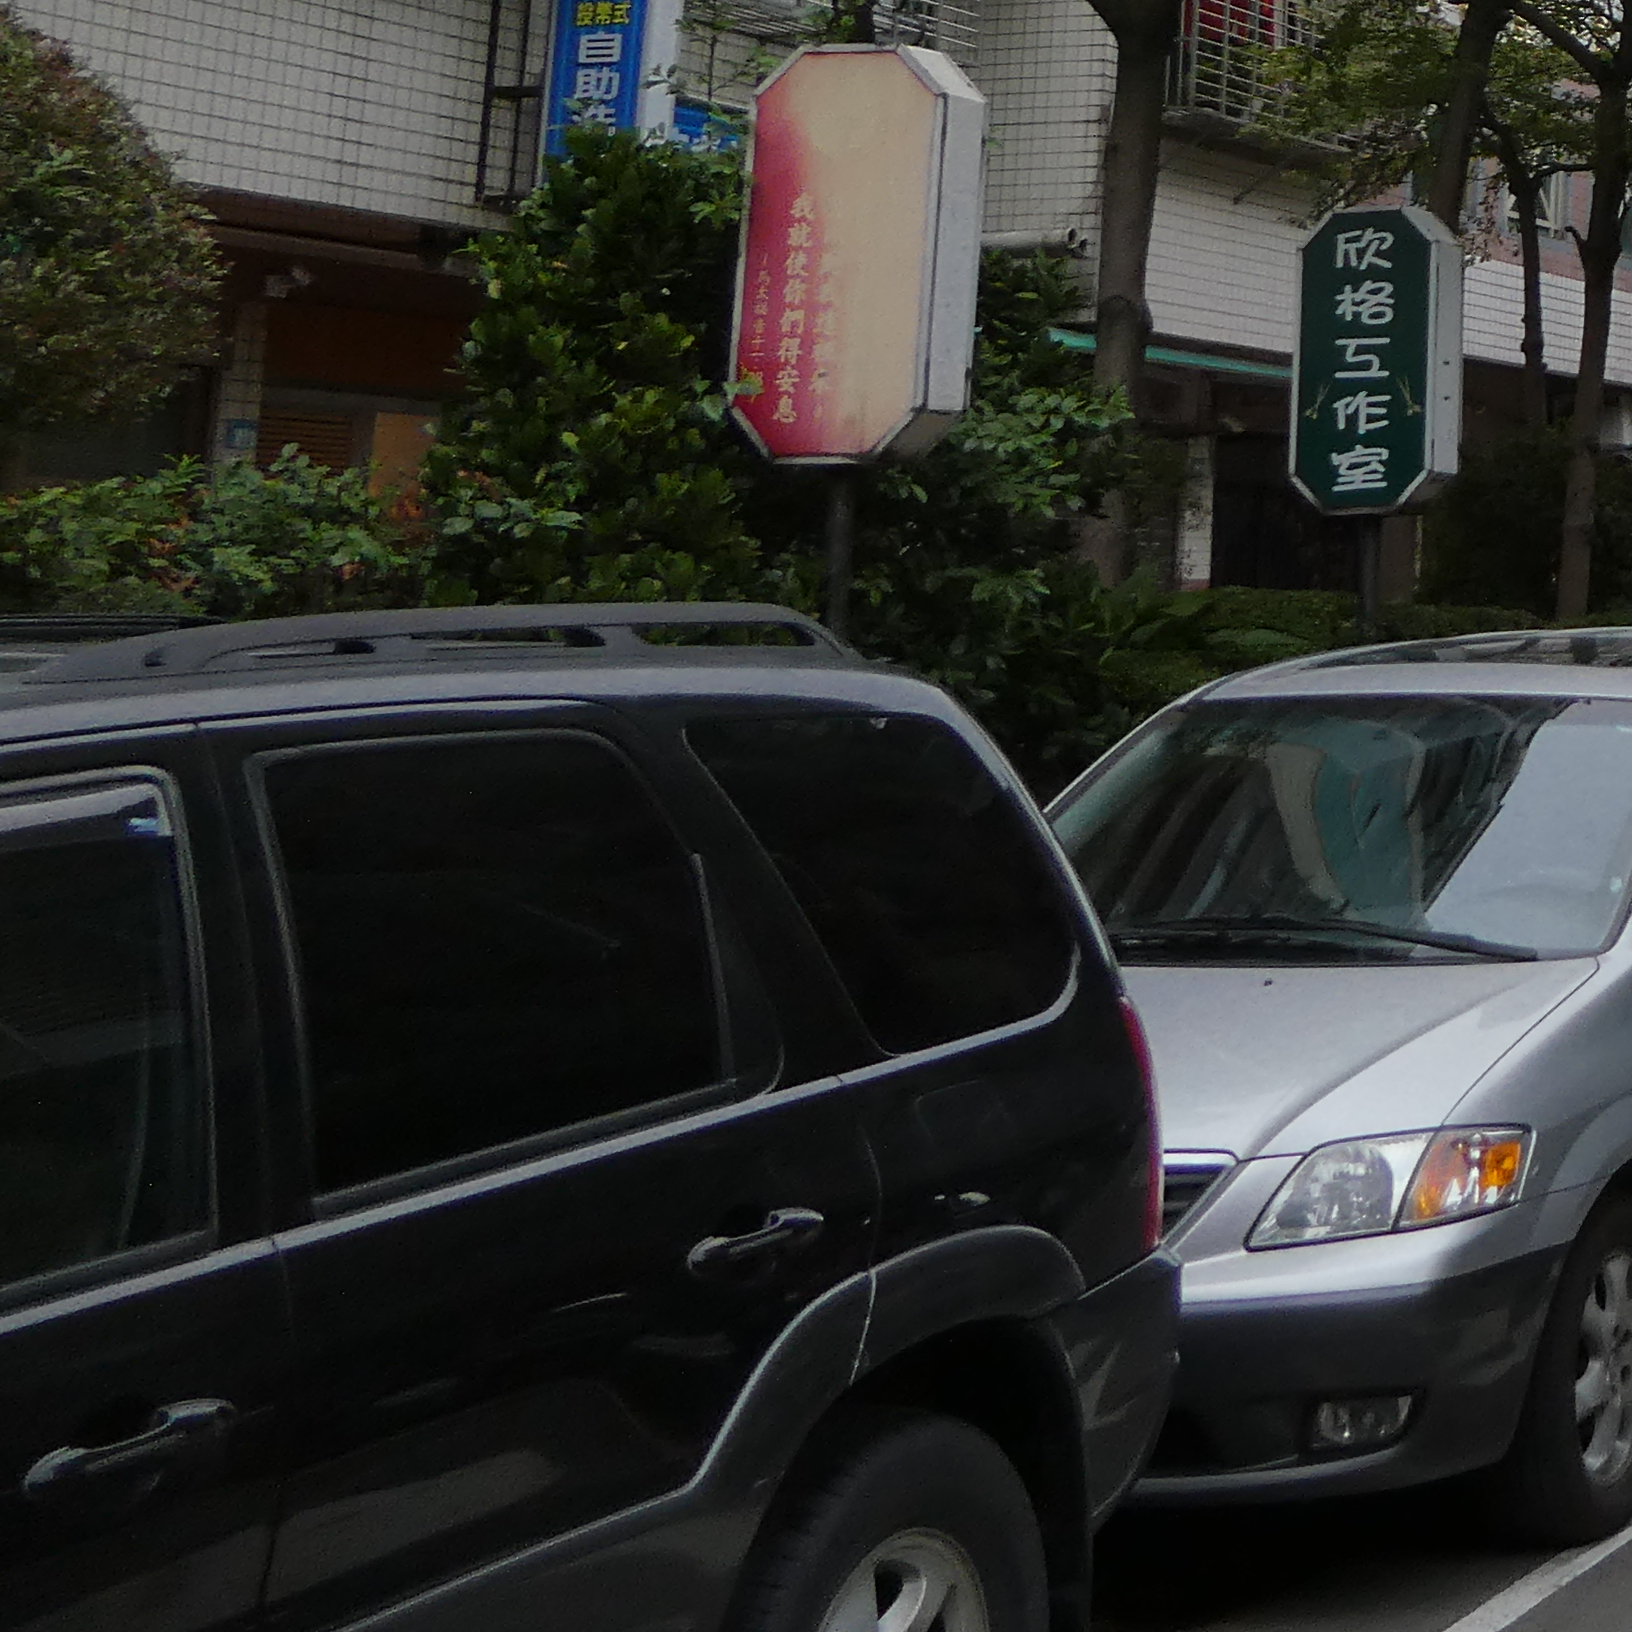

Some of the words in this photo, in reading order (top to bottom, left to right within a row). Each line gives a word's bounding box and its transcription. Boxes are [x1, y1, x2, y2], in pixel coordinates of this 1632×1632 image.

[1330, 226, 1395, 492] 欣格工作室
